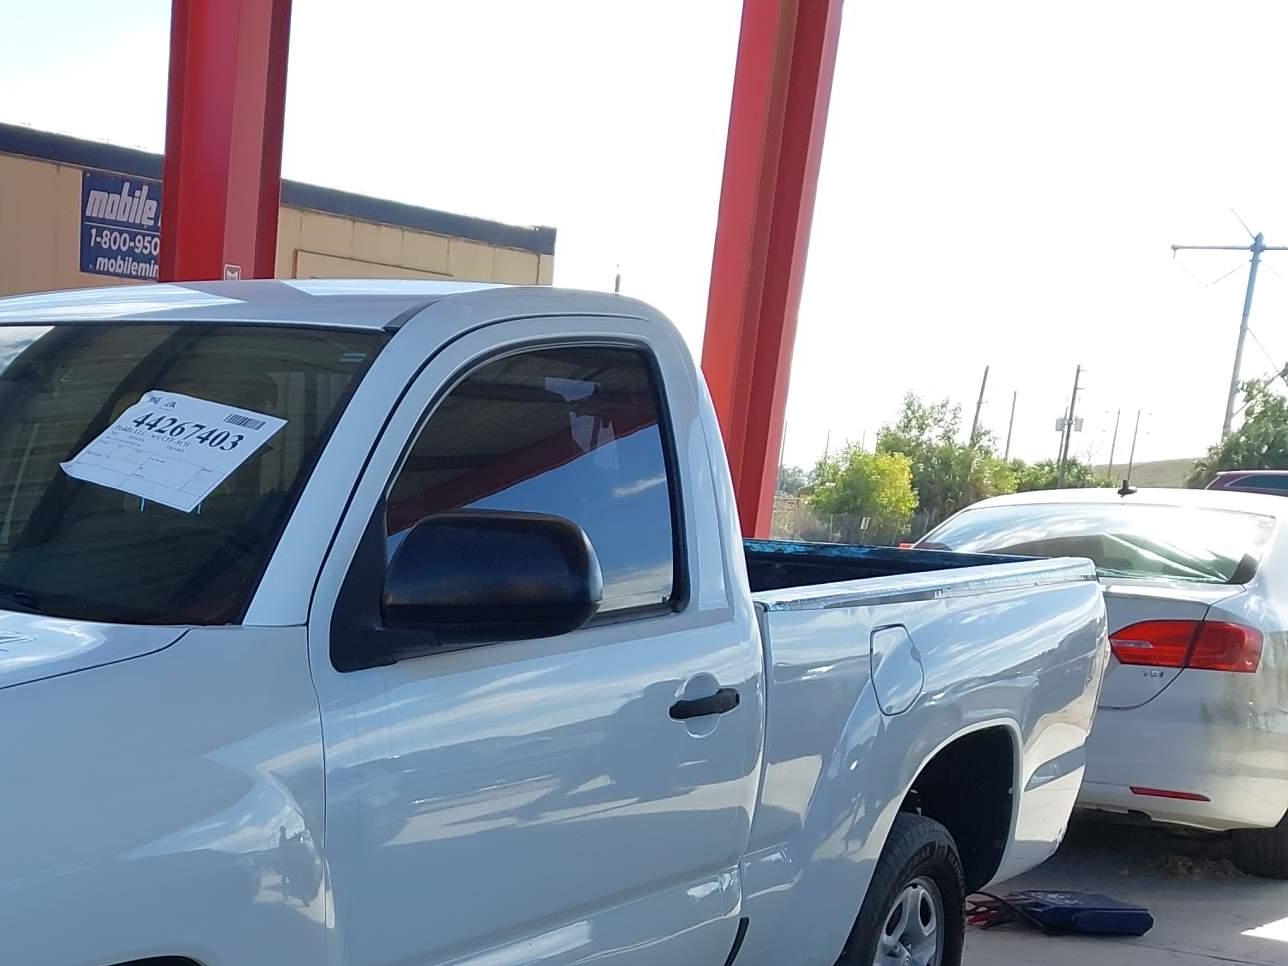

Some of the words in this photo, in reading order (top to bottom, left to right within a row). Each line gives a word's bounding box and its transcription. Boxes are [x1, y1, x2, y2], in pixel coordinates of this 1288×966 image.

[85, 182, 158, 226] mobile
[90, 228, 160, 256] 1-800-950
[133, 412, 245, 451] 44267403
